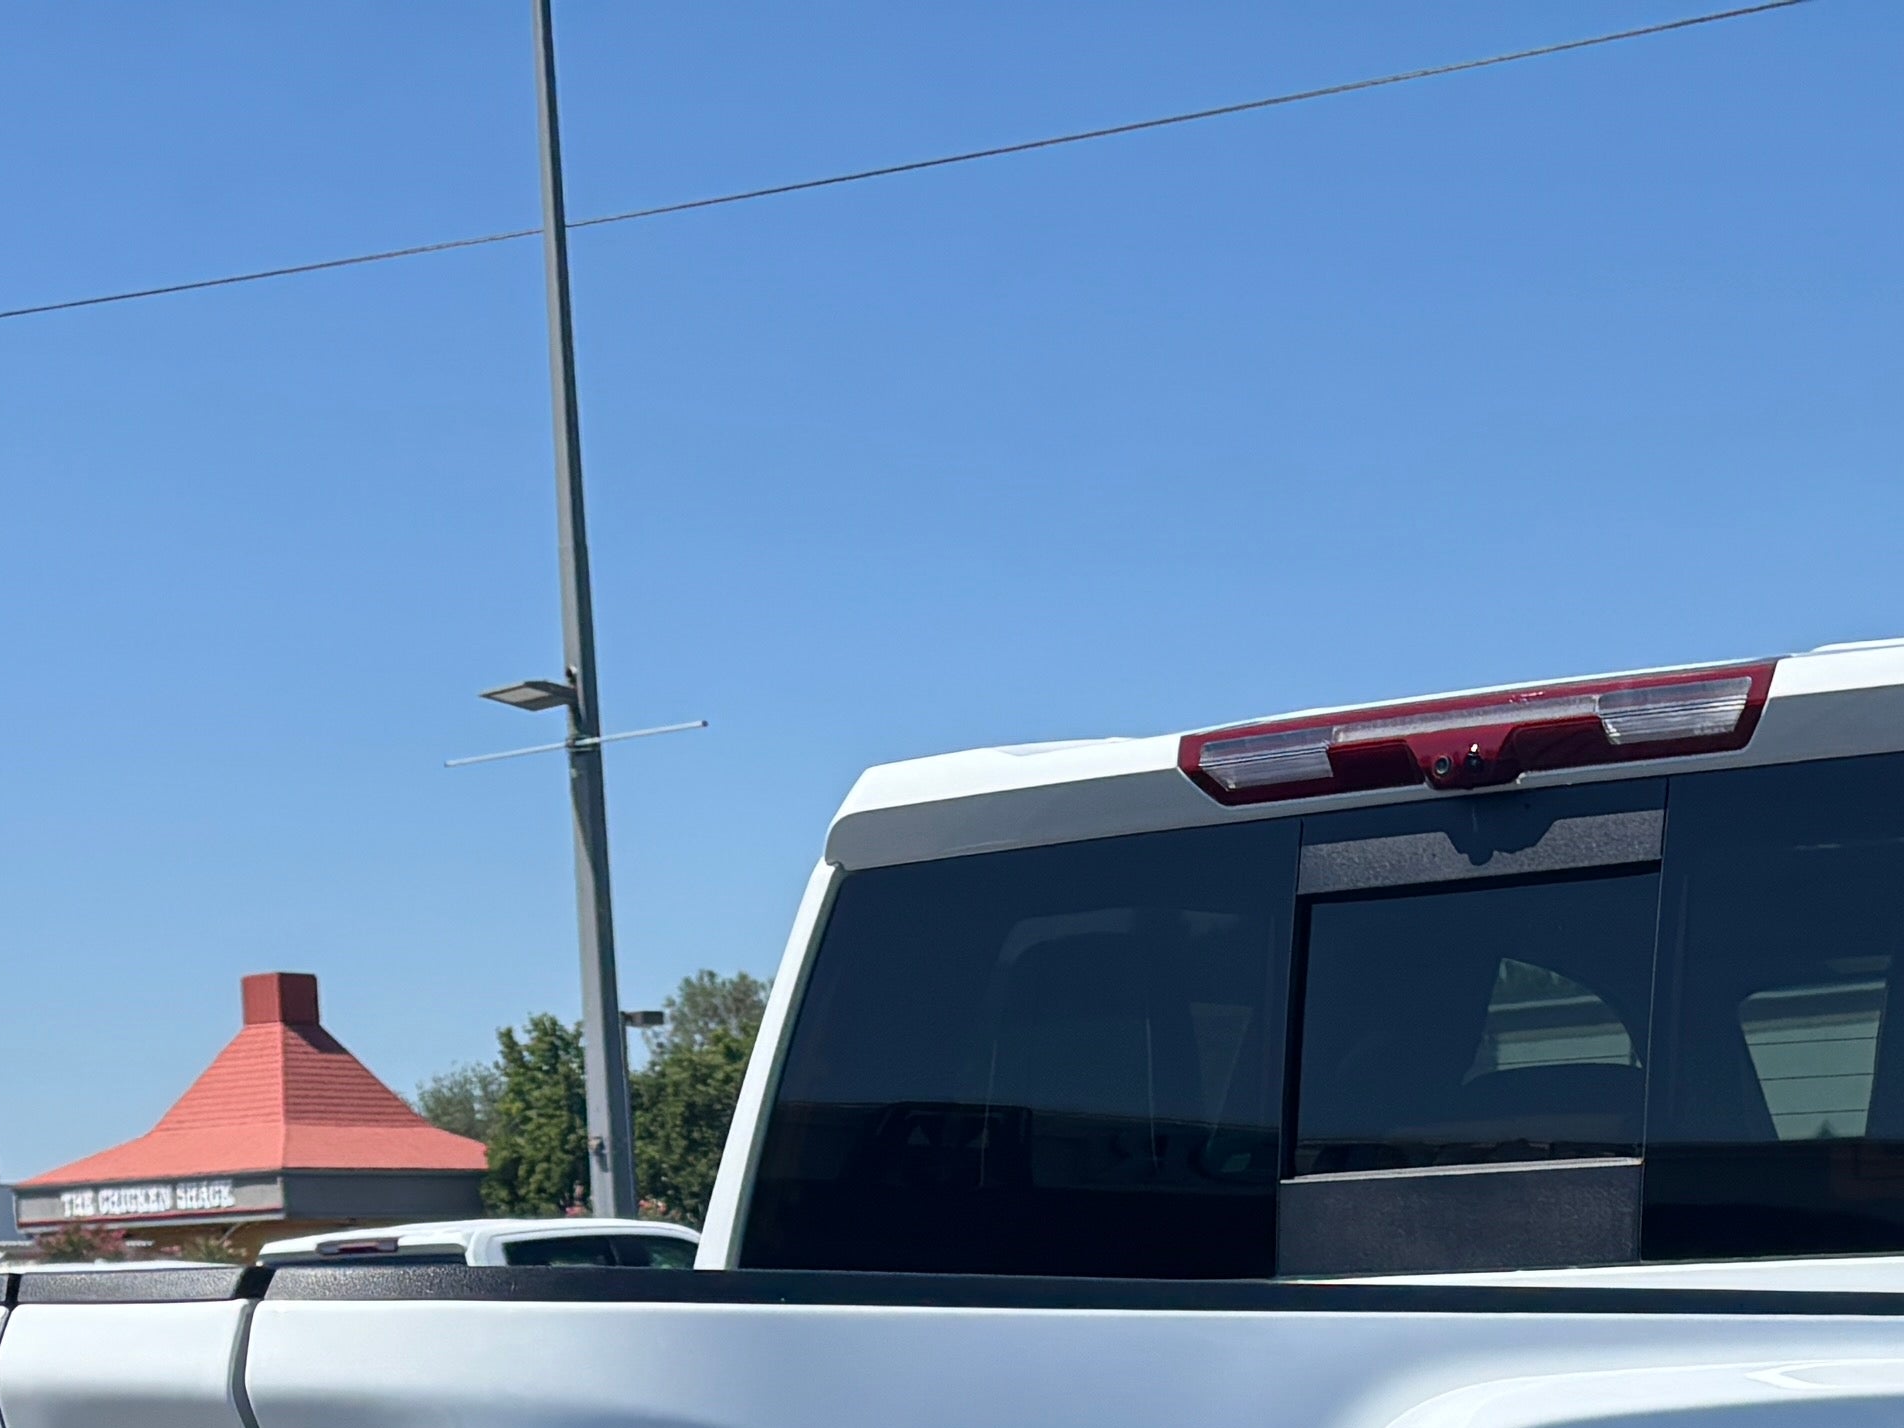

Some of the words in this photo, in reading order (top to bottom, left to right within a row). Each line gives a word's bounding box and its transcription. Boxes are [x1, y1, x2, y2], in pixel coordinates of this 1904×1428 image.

[60, 1189, 95, 1217] THE
[97, 1184, 173, 1215] CHICKEN
[175, 1178, 236, 1209] SHACK
